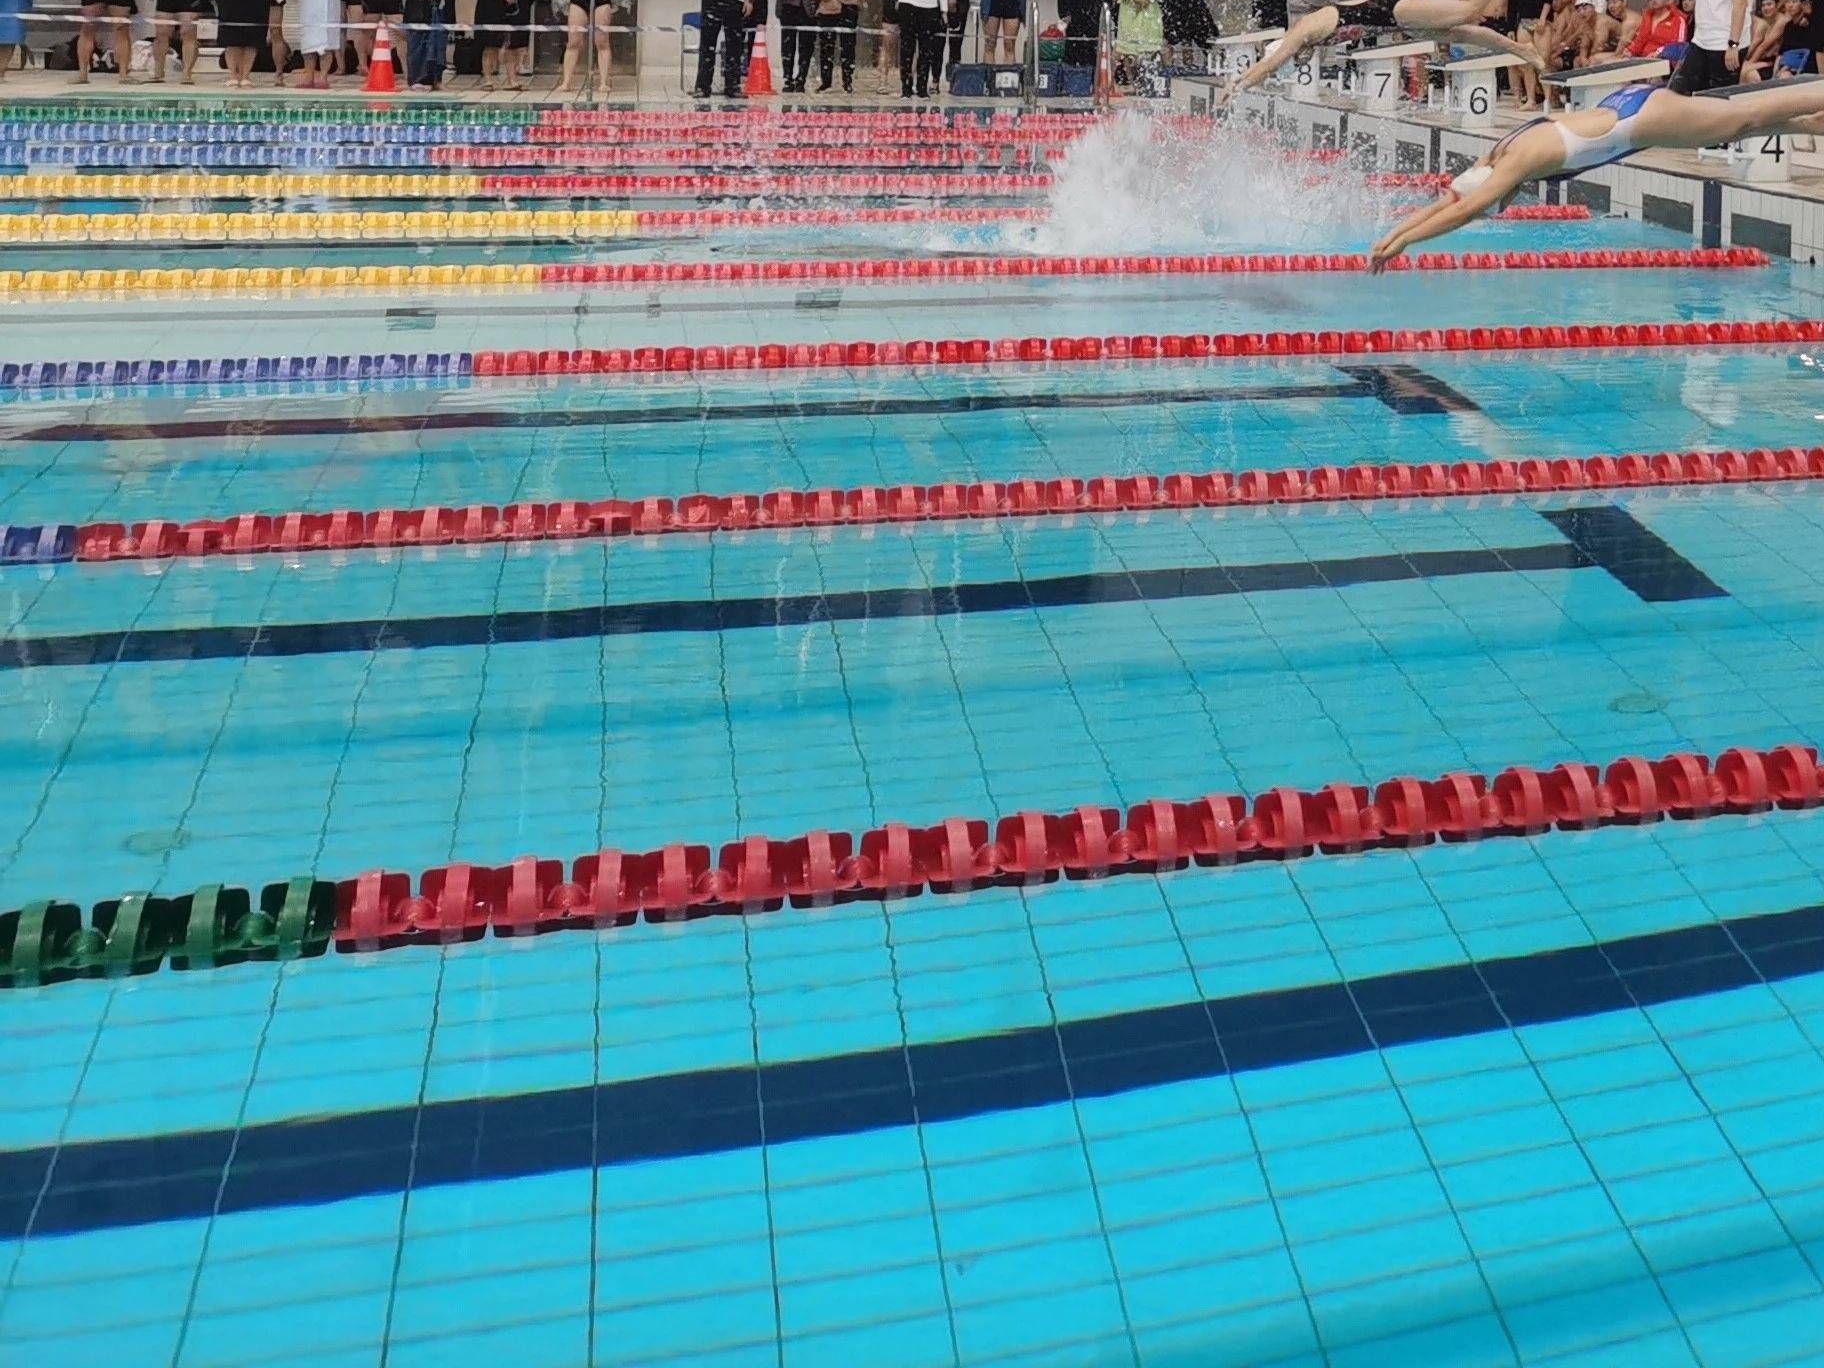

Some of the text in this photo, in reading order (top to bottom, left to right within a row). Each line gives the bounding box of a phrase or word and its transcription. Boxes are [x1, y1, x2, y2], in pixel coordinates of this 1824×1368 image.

[1297, 63, 1312, 86] 8
[1373, 72, 1392, 98] 7
[1470, 86, 1488, 114] 6
[1760, 134, 1785, 163] 4
